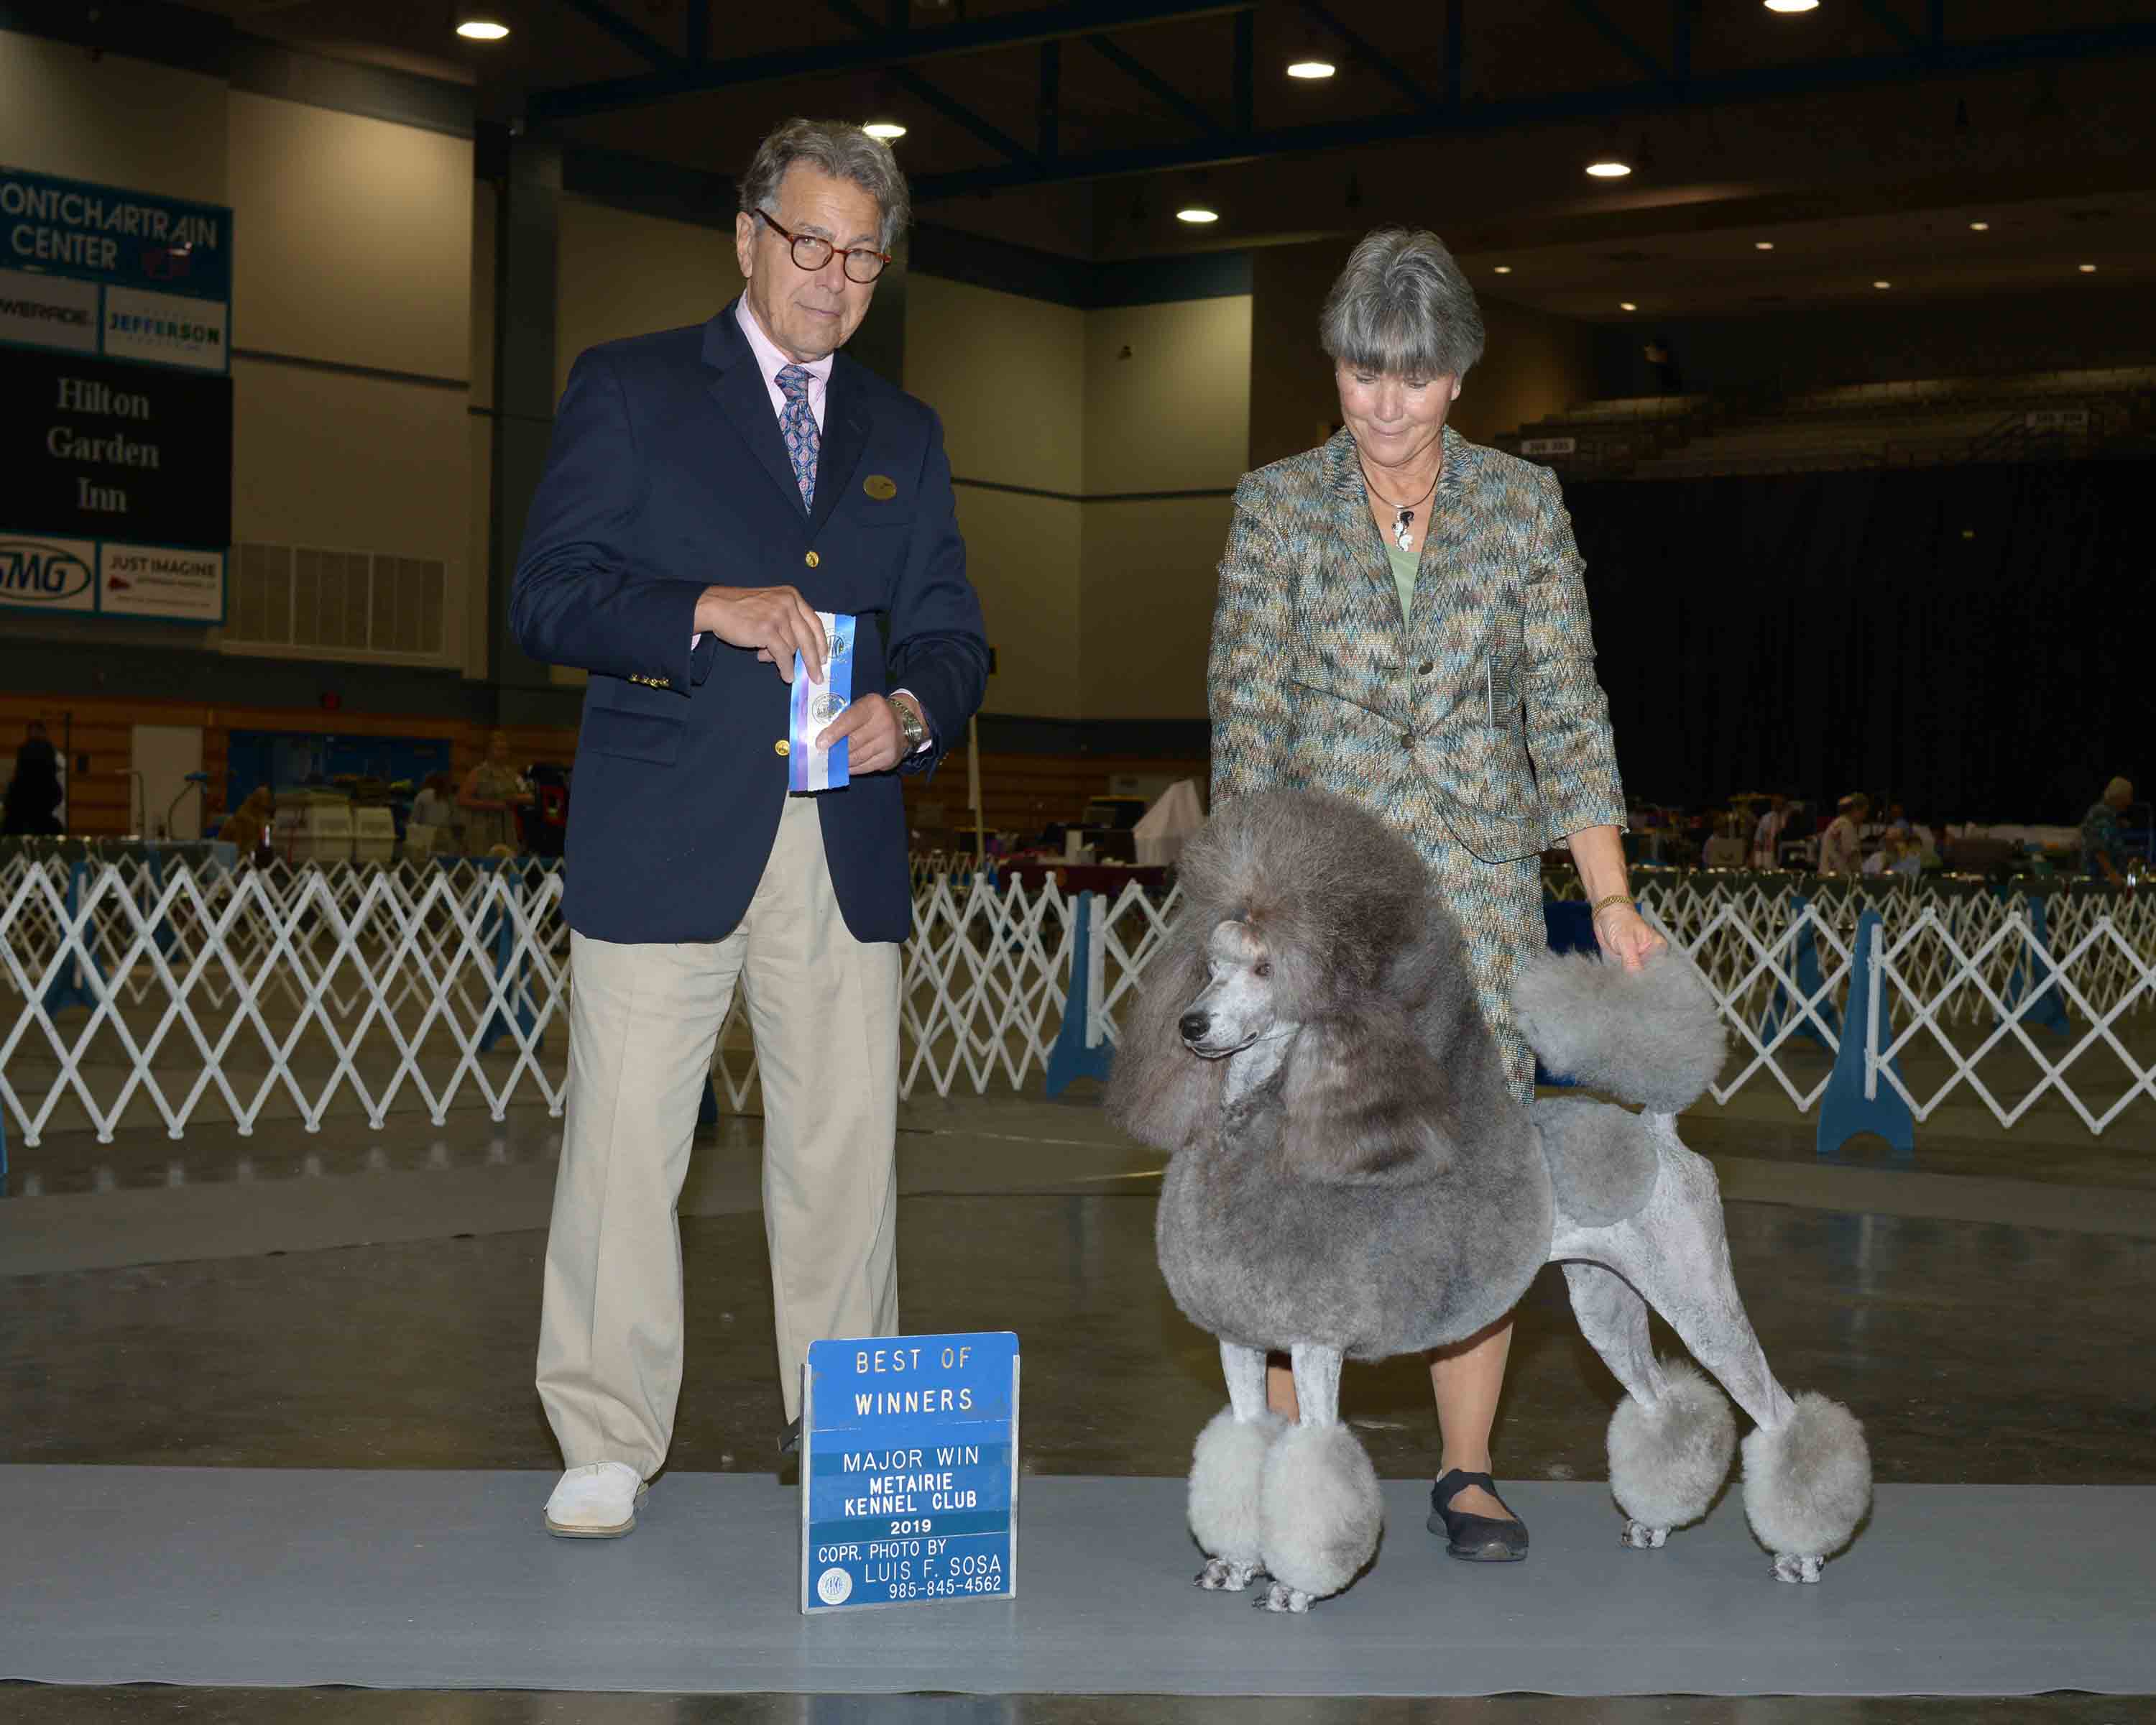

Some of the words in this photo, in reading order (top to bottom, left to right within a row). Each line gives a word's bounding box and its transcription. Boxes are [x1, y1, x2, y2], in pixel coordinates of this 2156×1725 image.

[1, 182, 218, 249] ONTCHARTRAIN
[11, 224, 117, 270] CENTER
[109, 312, 221, 344] JEFFERSON
[56, 377, 149, 420] Hilton
[47, 426, 160, 469] Garden
[76, 477, 126, 512] Inn
[0, 552, 68, 592] MG
[109, 556, 149, 572] JUST
[151, 558, 216, 577] IMAGINE
[856, 1349, 921, 1374] BEST
[941, 1347, 972, 1368] OF
[855, 1389, 972, 1414] WINNERS
[844, 1449, 922, 1473] MAJOR
[936, 1445, 979, 1466] WIN
[870, 1473, 954, 1494] METAIRIE
[845, 1494, 917, 1517] KENNEL
[932, 1490, 977, 1509] CLUB
[890, 1519, 931, 1534] 2019
[819, 1545, 862, 1563] COPR.
[870, 1540, 920, 1559] PHOTO
[928, 1539, 946, 1555] BY
[865, 1561, 911, 1583] LUIS
[923, 1560, 938, 1578] F.
[950, 1554, 1001, 1576] SOSA
[889, 1576, 1001, 1599] 985-845-4562
